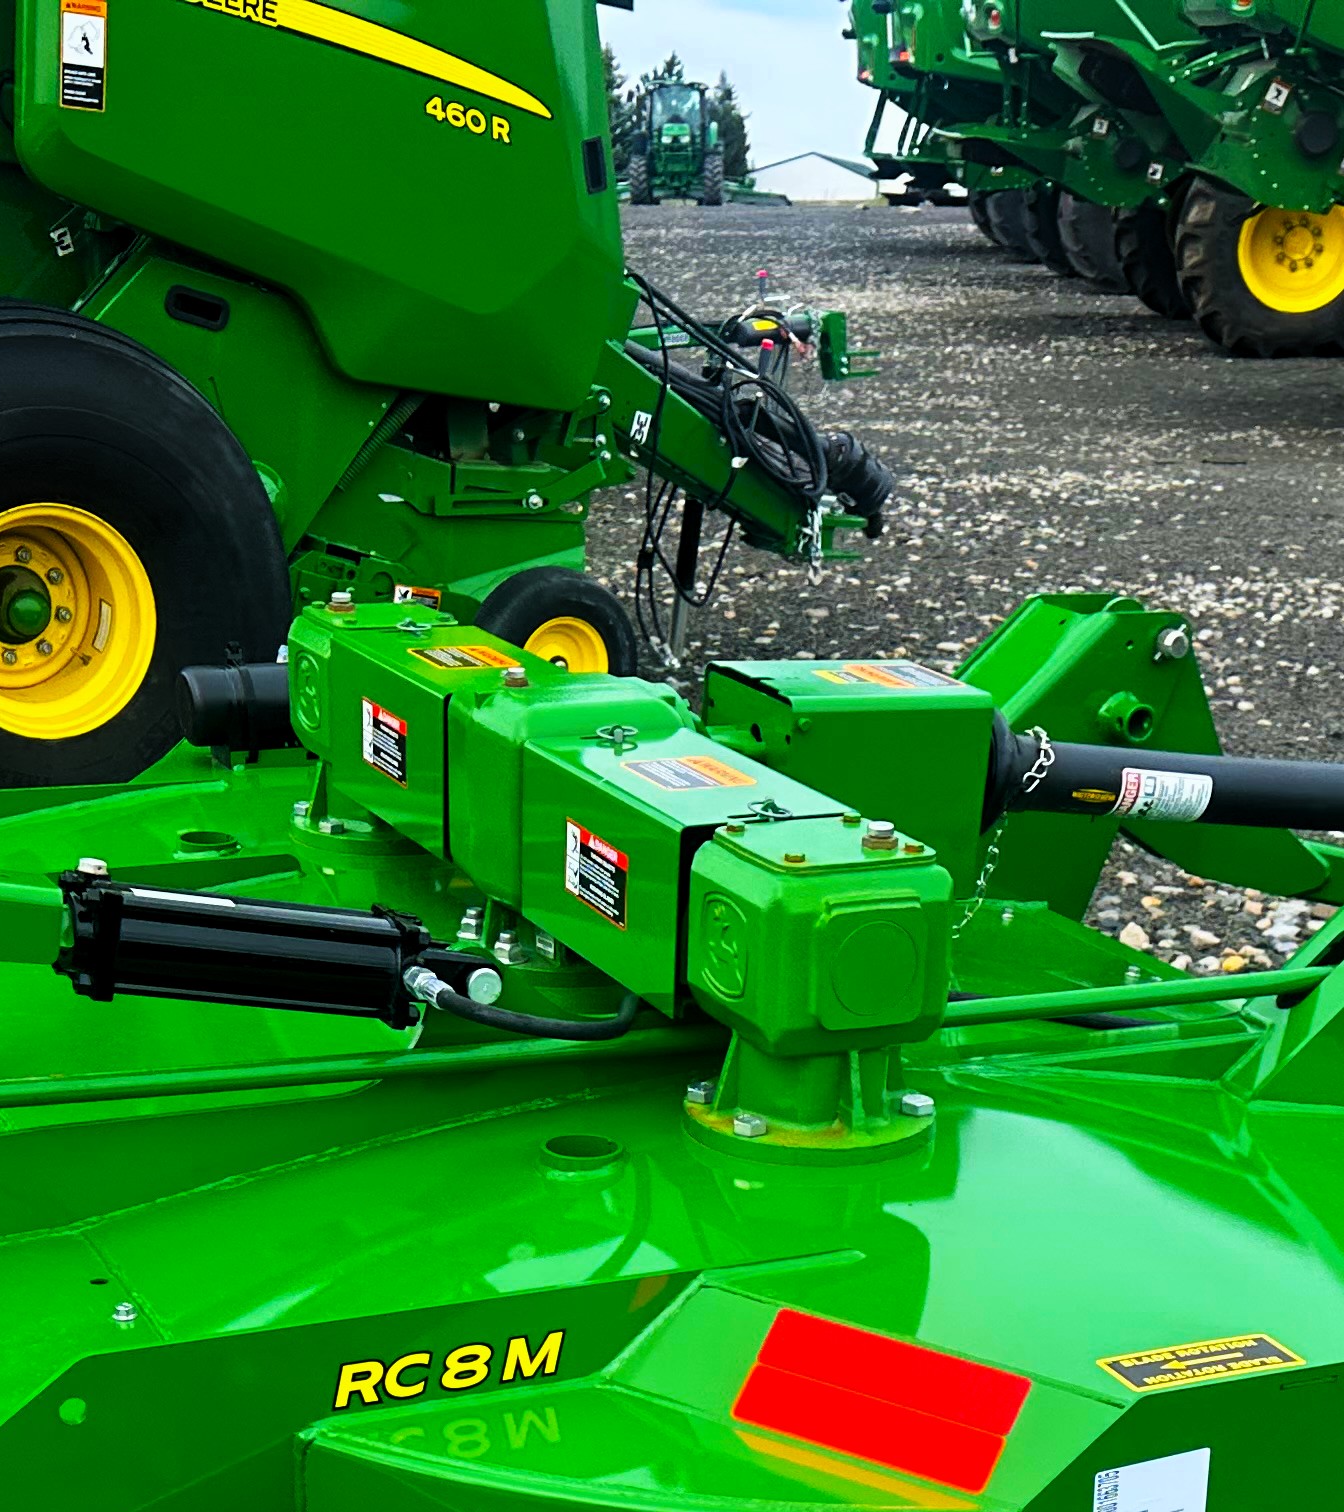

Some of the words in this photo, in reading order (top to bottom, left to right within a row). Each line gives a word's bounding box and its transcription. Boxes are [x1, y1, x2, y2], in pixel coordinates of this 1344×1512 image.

[206, 0, 279, 22] ERE
[425, 96, 487, 135] 460
[492, 115, 511, 144] R
[1119, 1352, 1176, 1368] BLADE
[1176, 1338, 1258, 1358] ROTATION
[1227, 1355, 1284, 1371] BLADE
[333, 1352, 433, 1410] RC
[440, 1343, 493, 1390] 8
[501, 1330, 565, 1382] M
[1142, 1364, 1227, 1386] ROTATION
